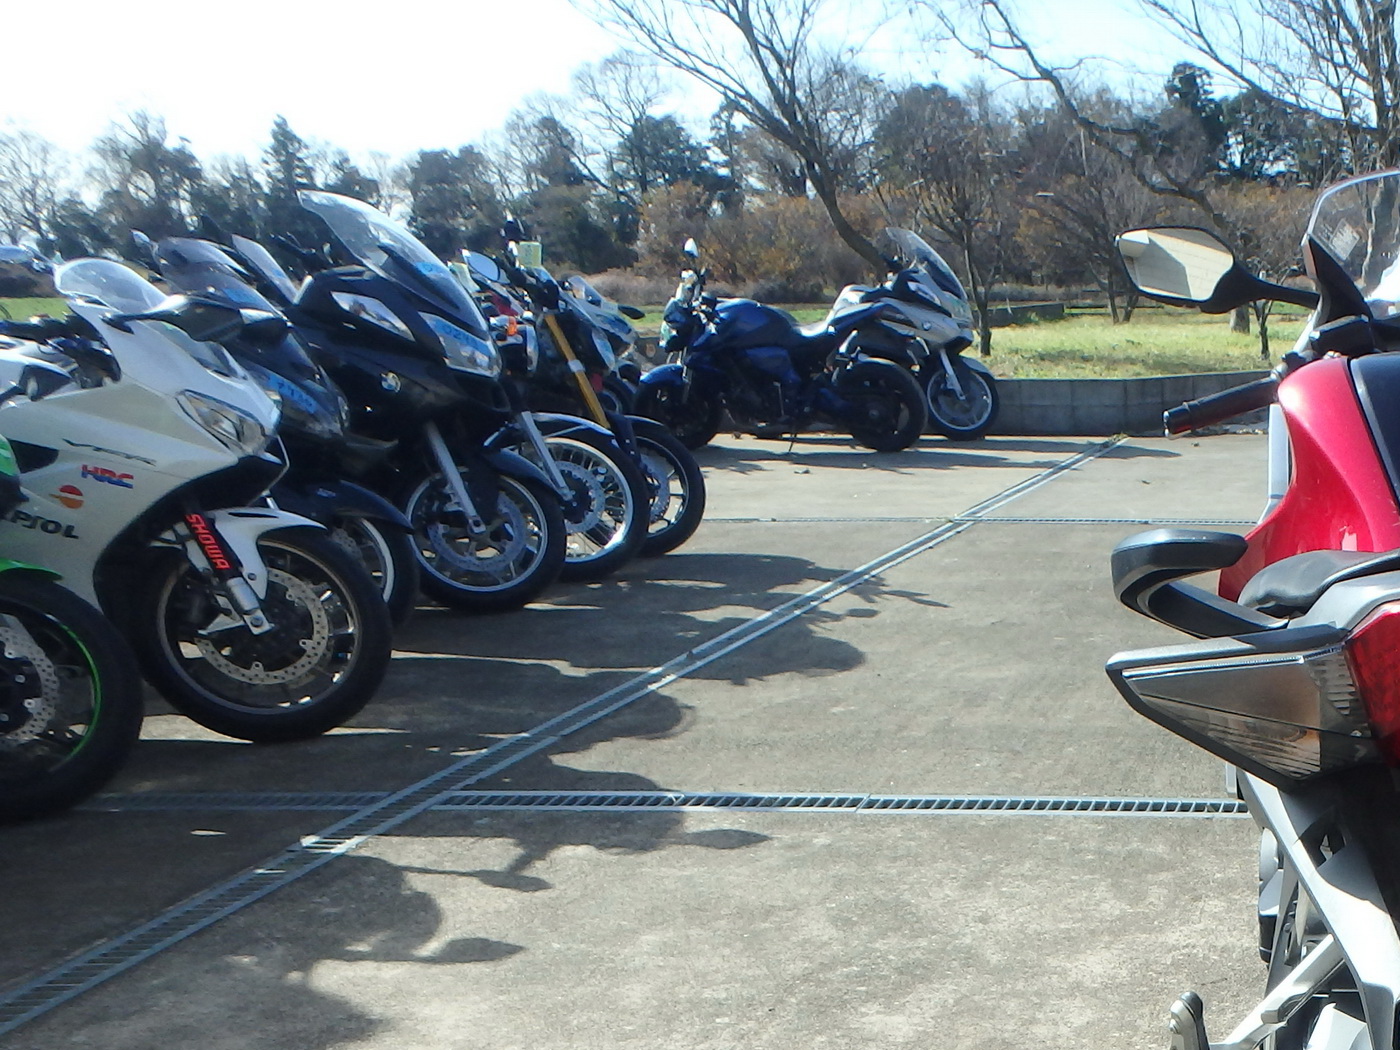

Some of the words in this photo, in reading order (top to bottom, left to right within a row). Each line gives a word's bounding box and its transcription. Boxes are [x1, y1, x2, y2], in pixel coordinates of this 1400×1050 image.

[81, 464, 134, 490] HRC
[11, 509, 79, 539] PSOL
[185, 513, 230, 569] SHOWA
